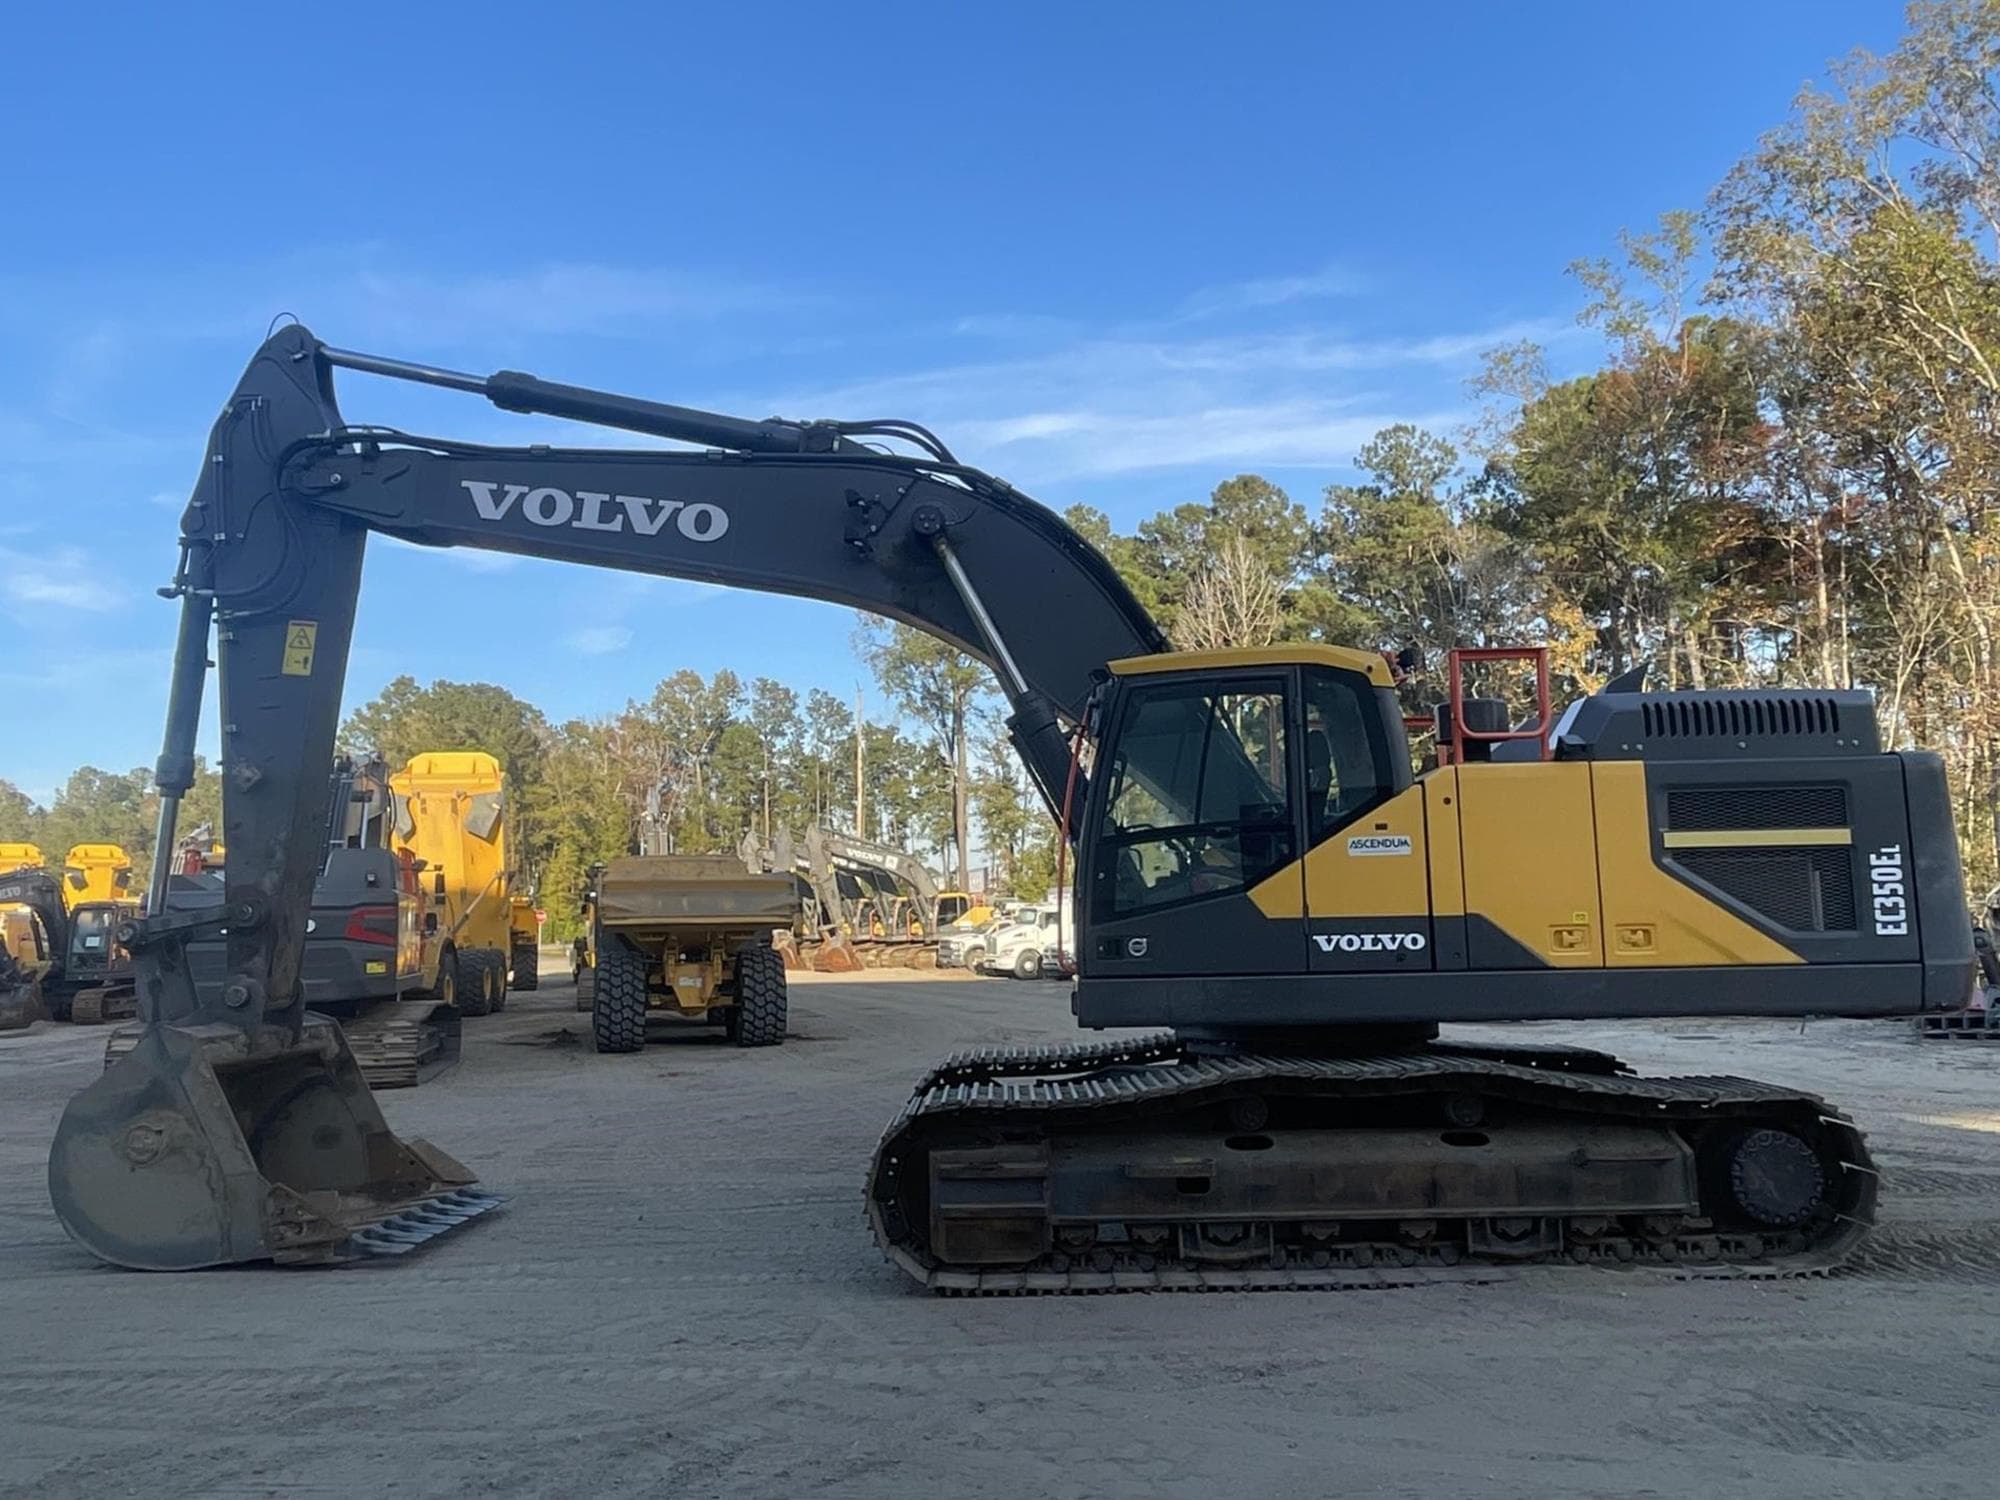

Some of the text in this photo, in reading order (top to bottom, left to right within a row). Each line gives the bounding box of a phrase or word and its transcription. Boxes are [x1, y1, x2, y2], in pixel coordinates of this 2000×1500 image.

[461, 480, 729, 542] VOLVO
[1349, 838, 1410, 849] ASCENDUM
[1312, 933, 1425, 952] VOLVO
